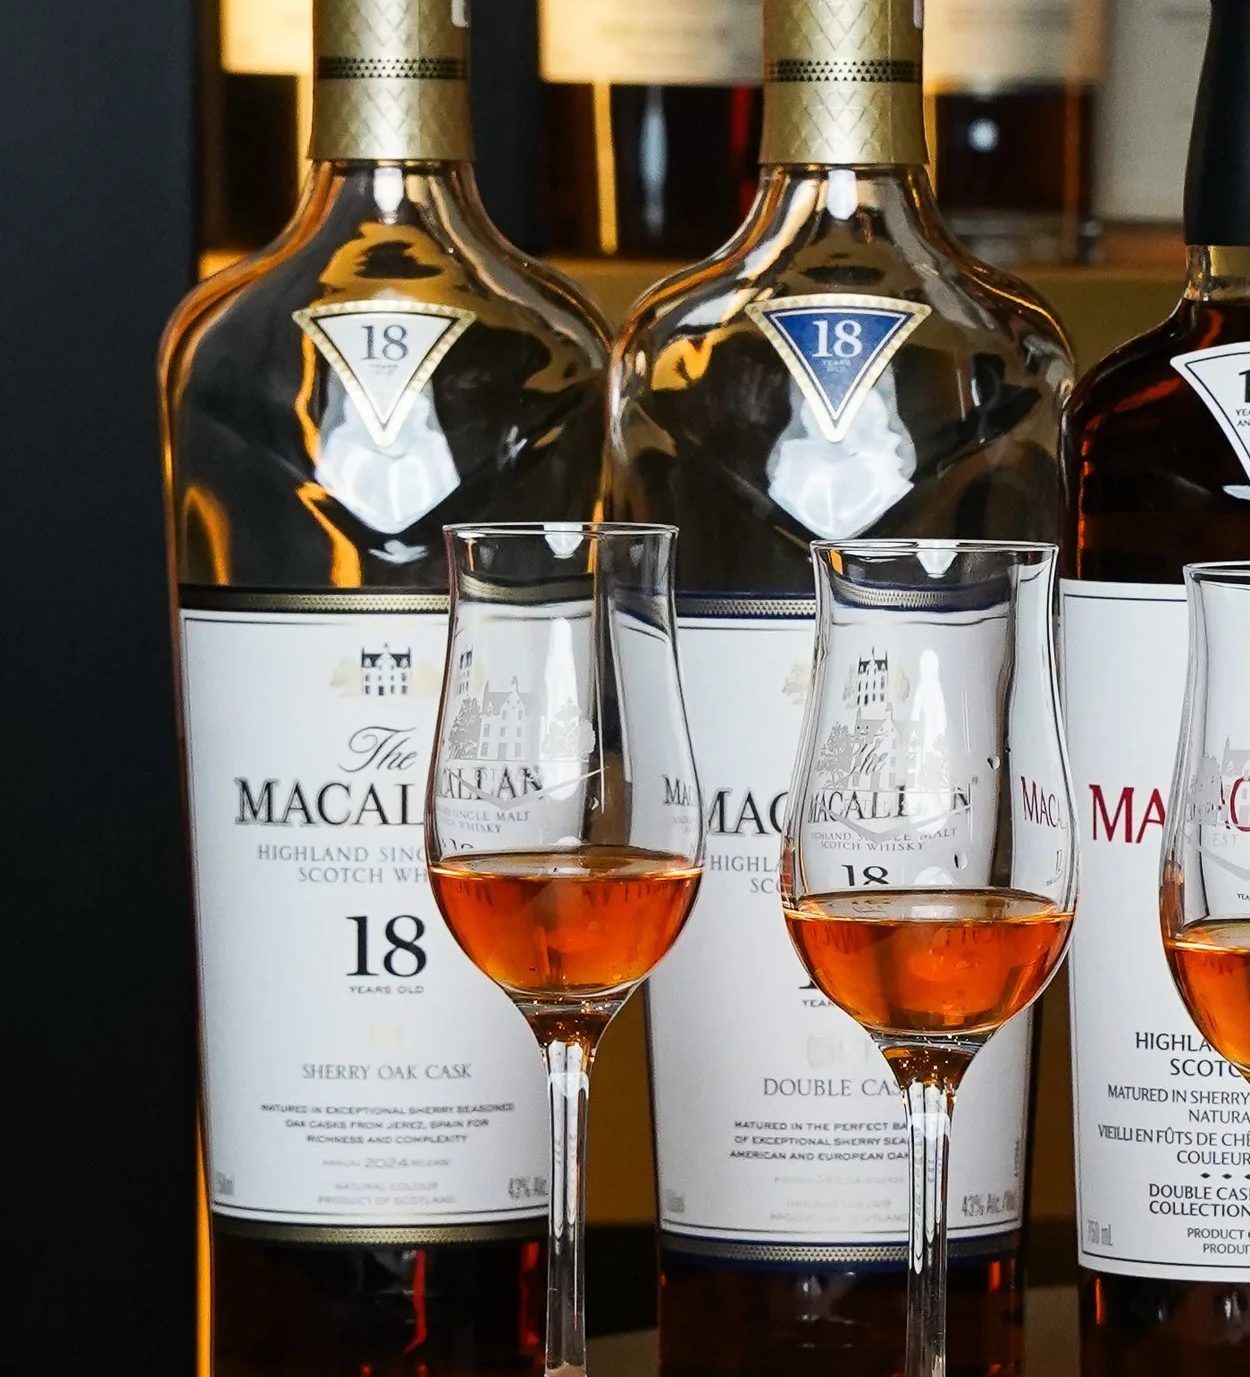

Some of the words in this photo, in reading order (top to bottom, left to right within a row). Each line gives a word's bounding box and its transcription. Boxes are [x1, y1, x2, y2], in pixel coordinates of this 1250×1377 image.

[361, 324, 409, 361] 18
[811, 320, 863, 358] 18
[339, 726, 419, 772] The
[258, 845, 367, 863] HIGHLAND
[378, 845, 425, 863] SING
[866, 841, 926, 851] WHISKY
[297, 868, 383, 884] SCOTCH
[346, 915, 426, 977] 18
[349, 985, 393, 993] YEARS
[399, 985, 425, 993] OLD
[302, 1064, 368, 1080] SHERRY
[377, 1064, 418, 1080] OAK
[425, 1064, 472, 1079] CASK
[1170, 1059, 1241, 1078] SCOTC
[763, 1078, 851, 1097] DOUBLE
[862, 1078, 901, 1096] CAS
[1108, 1085, 1167, 1103] MATURED
[1171, 1090, 1186, 1103] IN
[1190, 1091, 1249, 1105] SHERRY
[735, 1121, 787, 1130] MATURED
[792, 1123, 803, 1131] IN
[807, 1122, 830, 1131] THE
[834, 1123, 888, 1131] PERFECT
[735, 1135, 748, 1143] OF
[752, 1136, 831, 1145] EXCEPTIONAL
[834, 1137, 880, 1145] SHERRY
[1098, 1126, 1133, 1142] VIEILLI
[1136, 1130, 1153, 1142] EN
[1157, 1126, 1192, 1145] FÛTS
[1197, 1132, 1218, 1146] DE
[730, 1151, 786, 1160] AMERICAN
[1149, 1184, 1211, 1201] DOUBLE
[1187, 1227, 1243, 1240] PRODUCT
